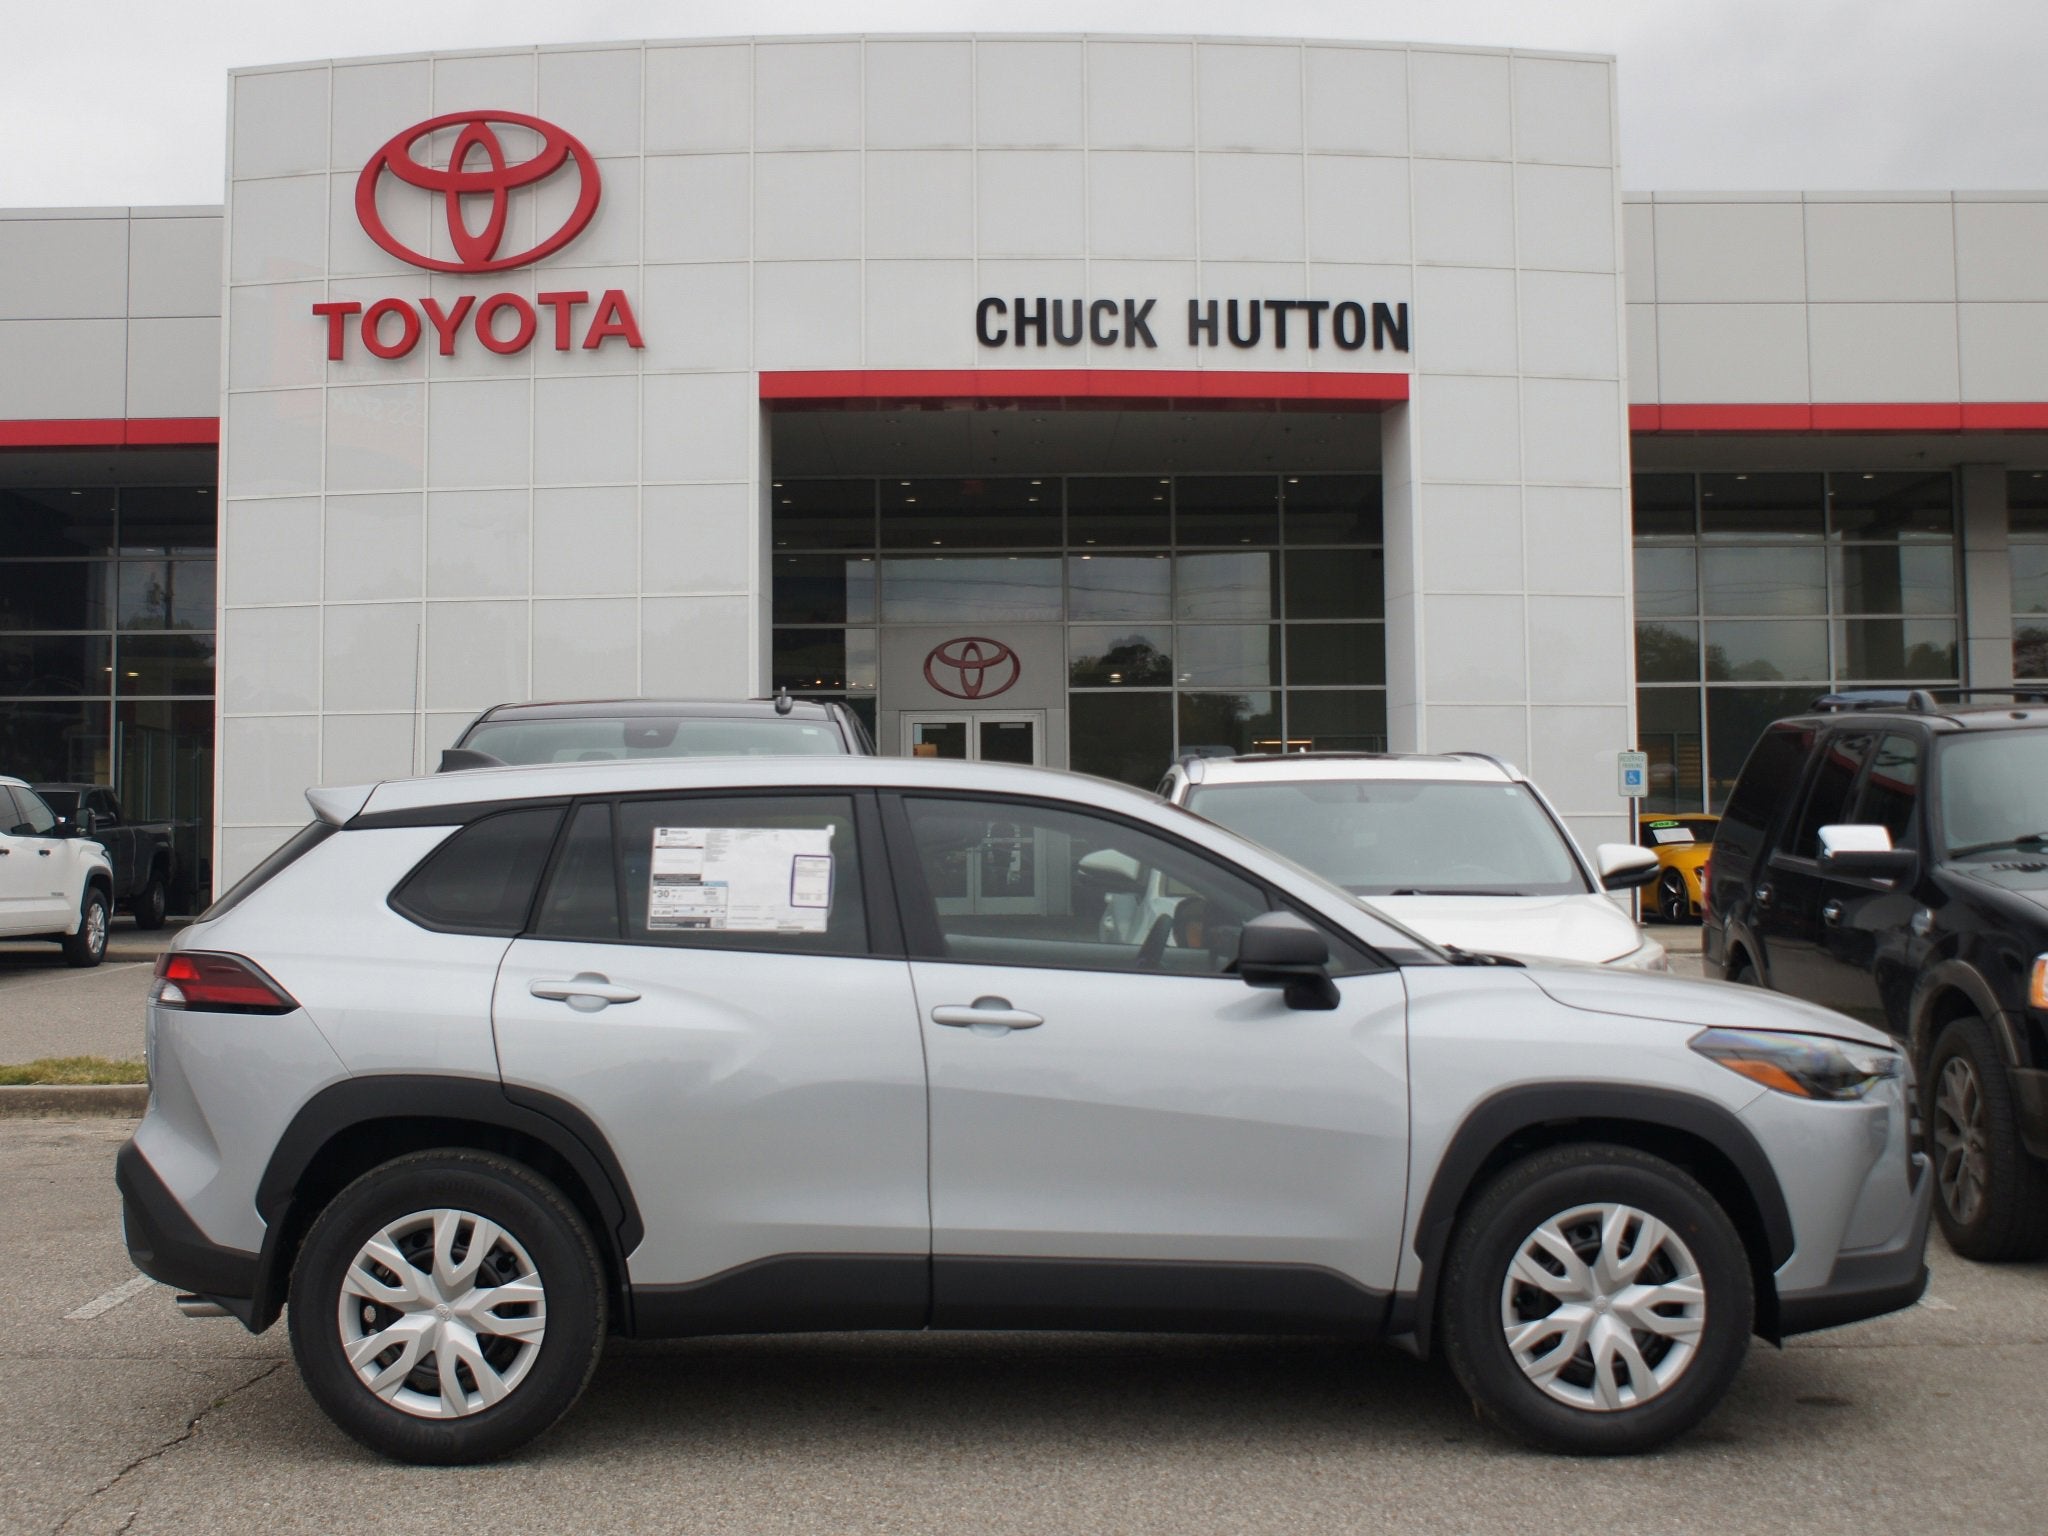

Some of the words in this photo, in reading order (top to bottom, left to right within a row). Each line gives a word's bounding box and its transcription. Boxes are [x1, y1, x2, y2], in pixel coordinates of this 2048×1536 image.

[312, 289, 646, 361] TOYOTA
[976, 297, 1157, 348] CHUCK
[1188, 299, 1409, 353] HUTTON
[657, 889, 670, 898] 30
